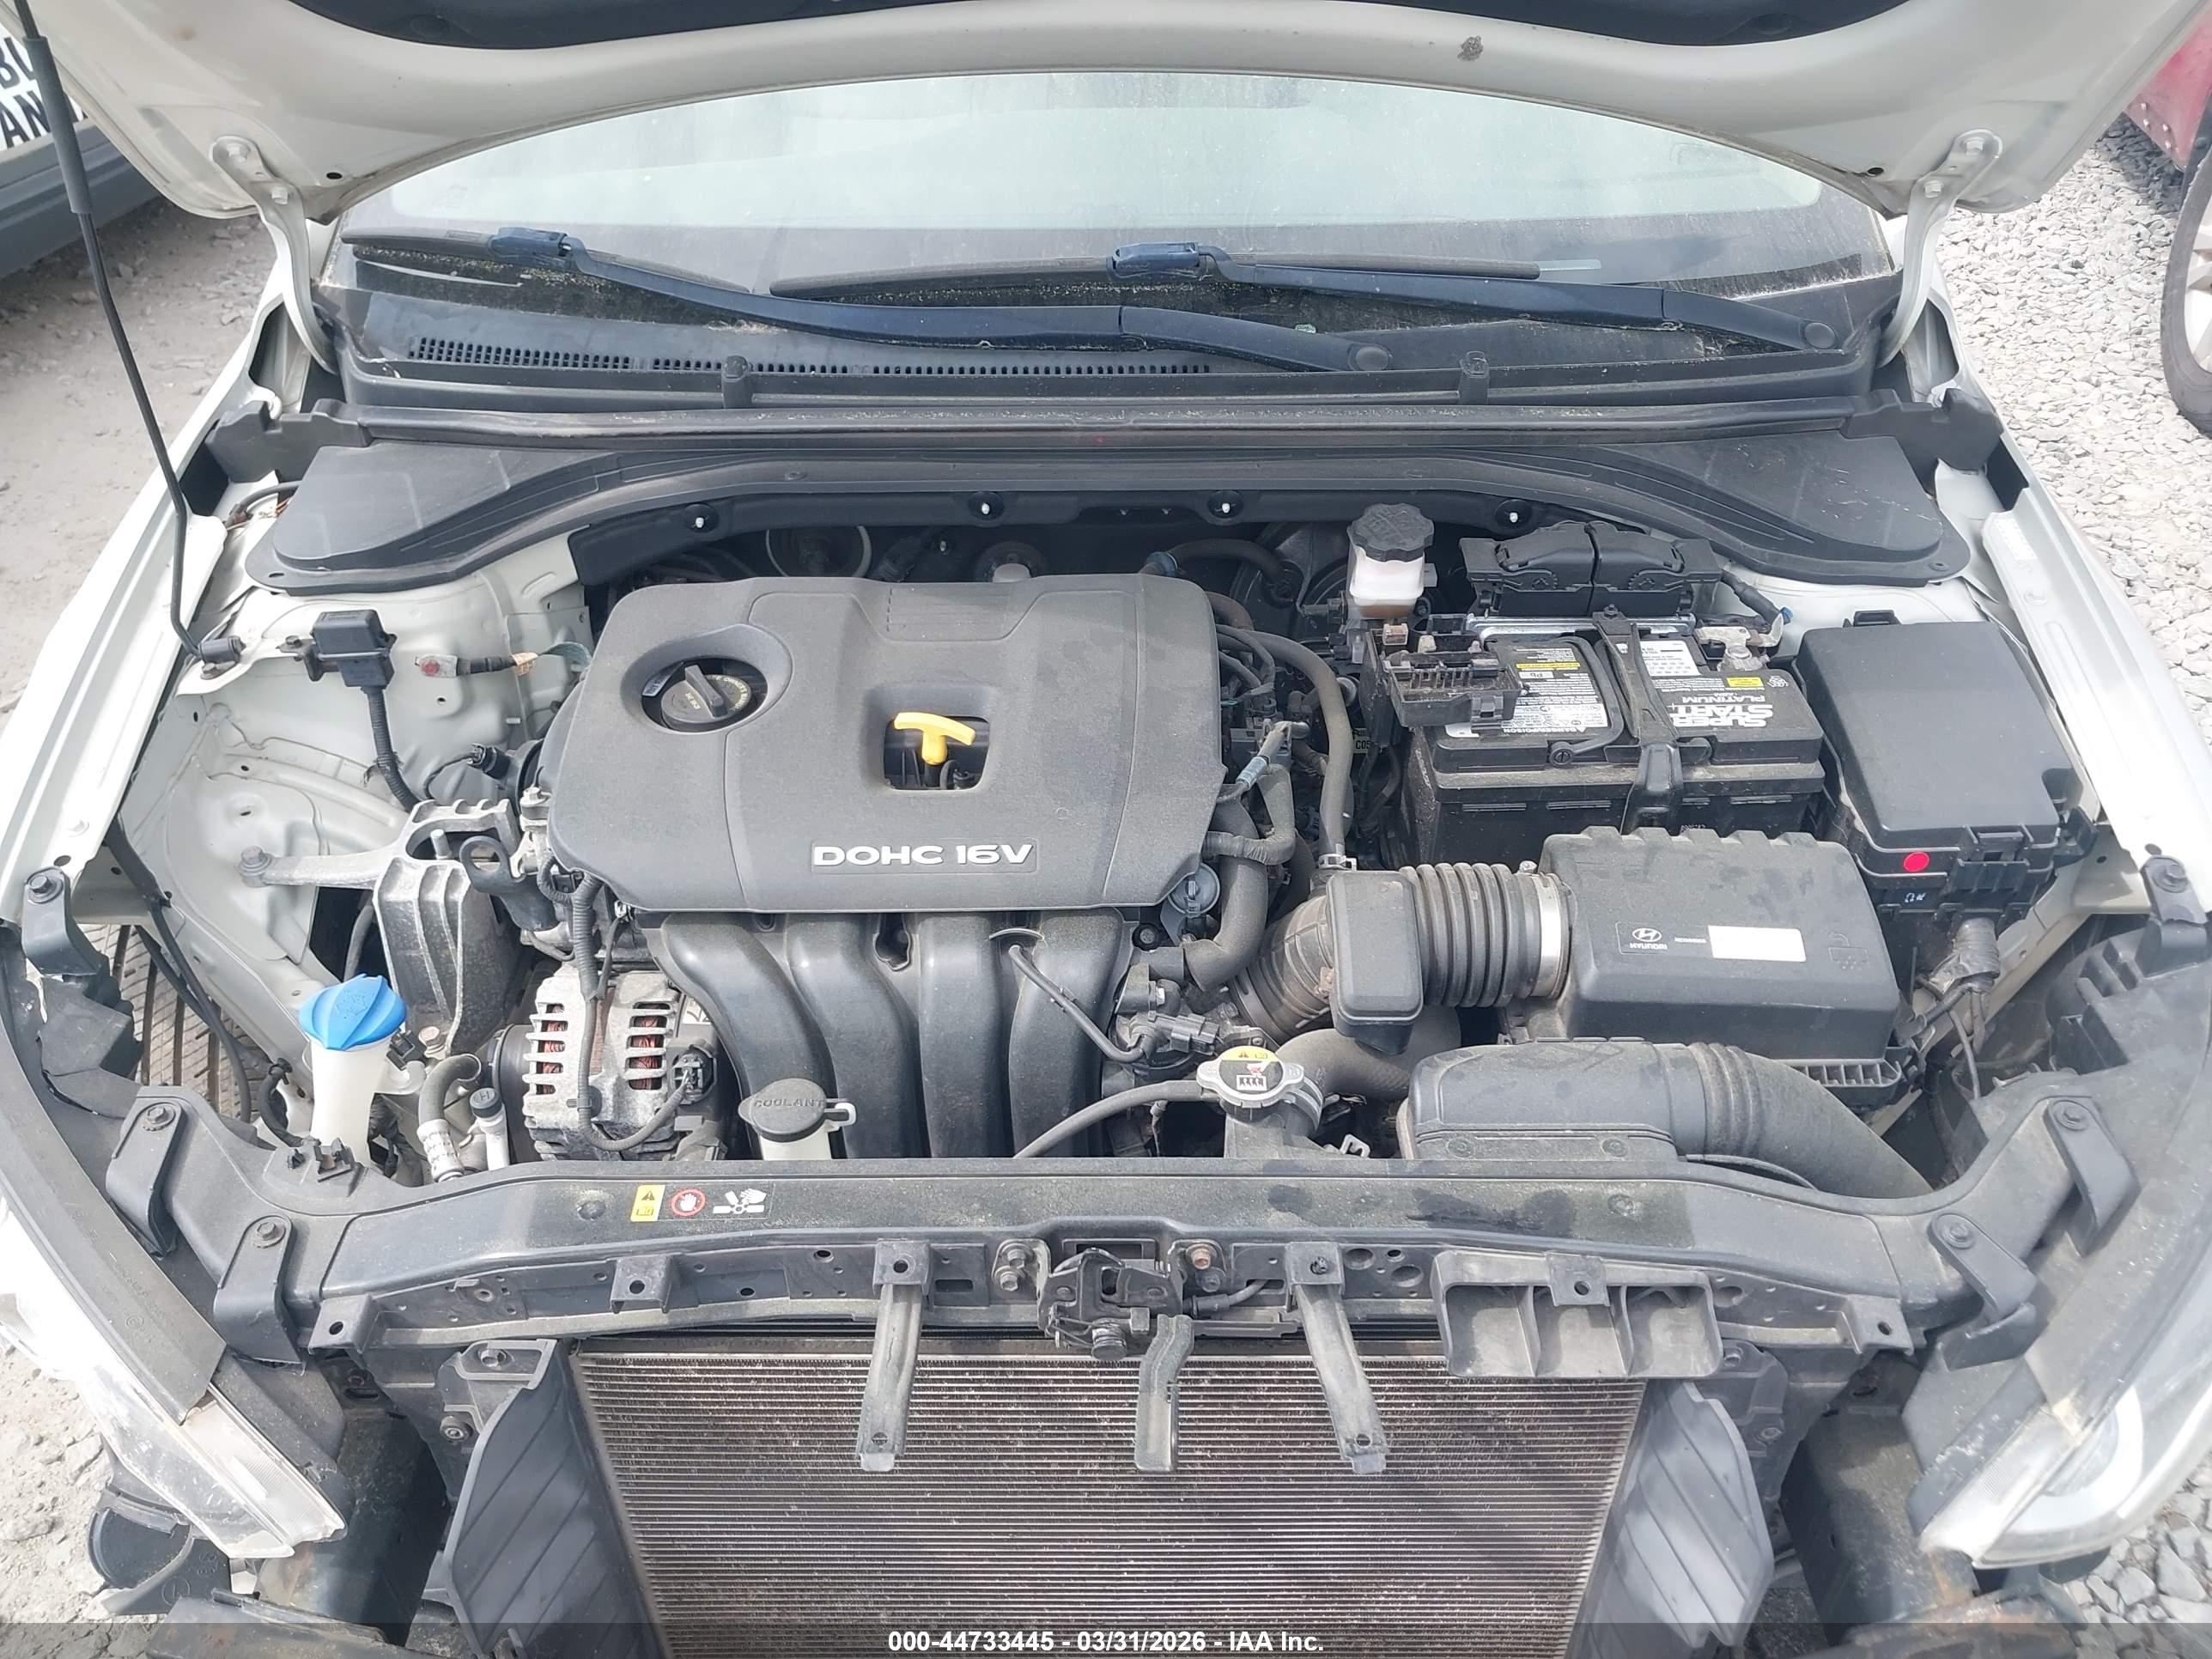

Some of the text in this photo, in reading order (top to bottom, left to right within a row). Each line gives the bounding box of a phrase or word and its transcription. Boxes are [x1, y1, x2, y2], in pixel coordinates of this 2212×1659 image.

[1668, 704, 1773, 718] START
[1672, 715, 1767, 727] SUPER
[813, 844, 1033, 866] DOHC 16V
[754, 1098, 824, 1108] COOLANT
